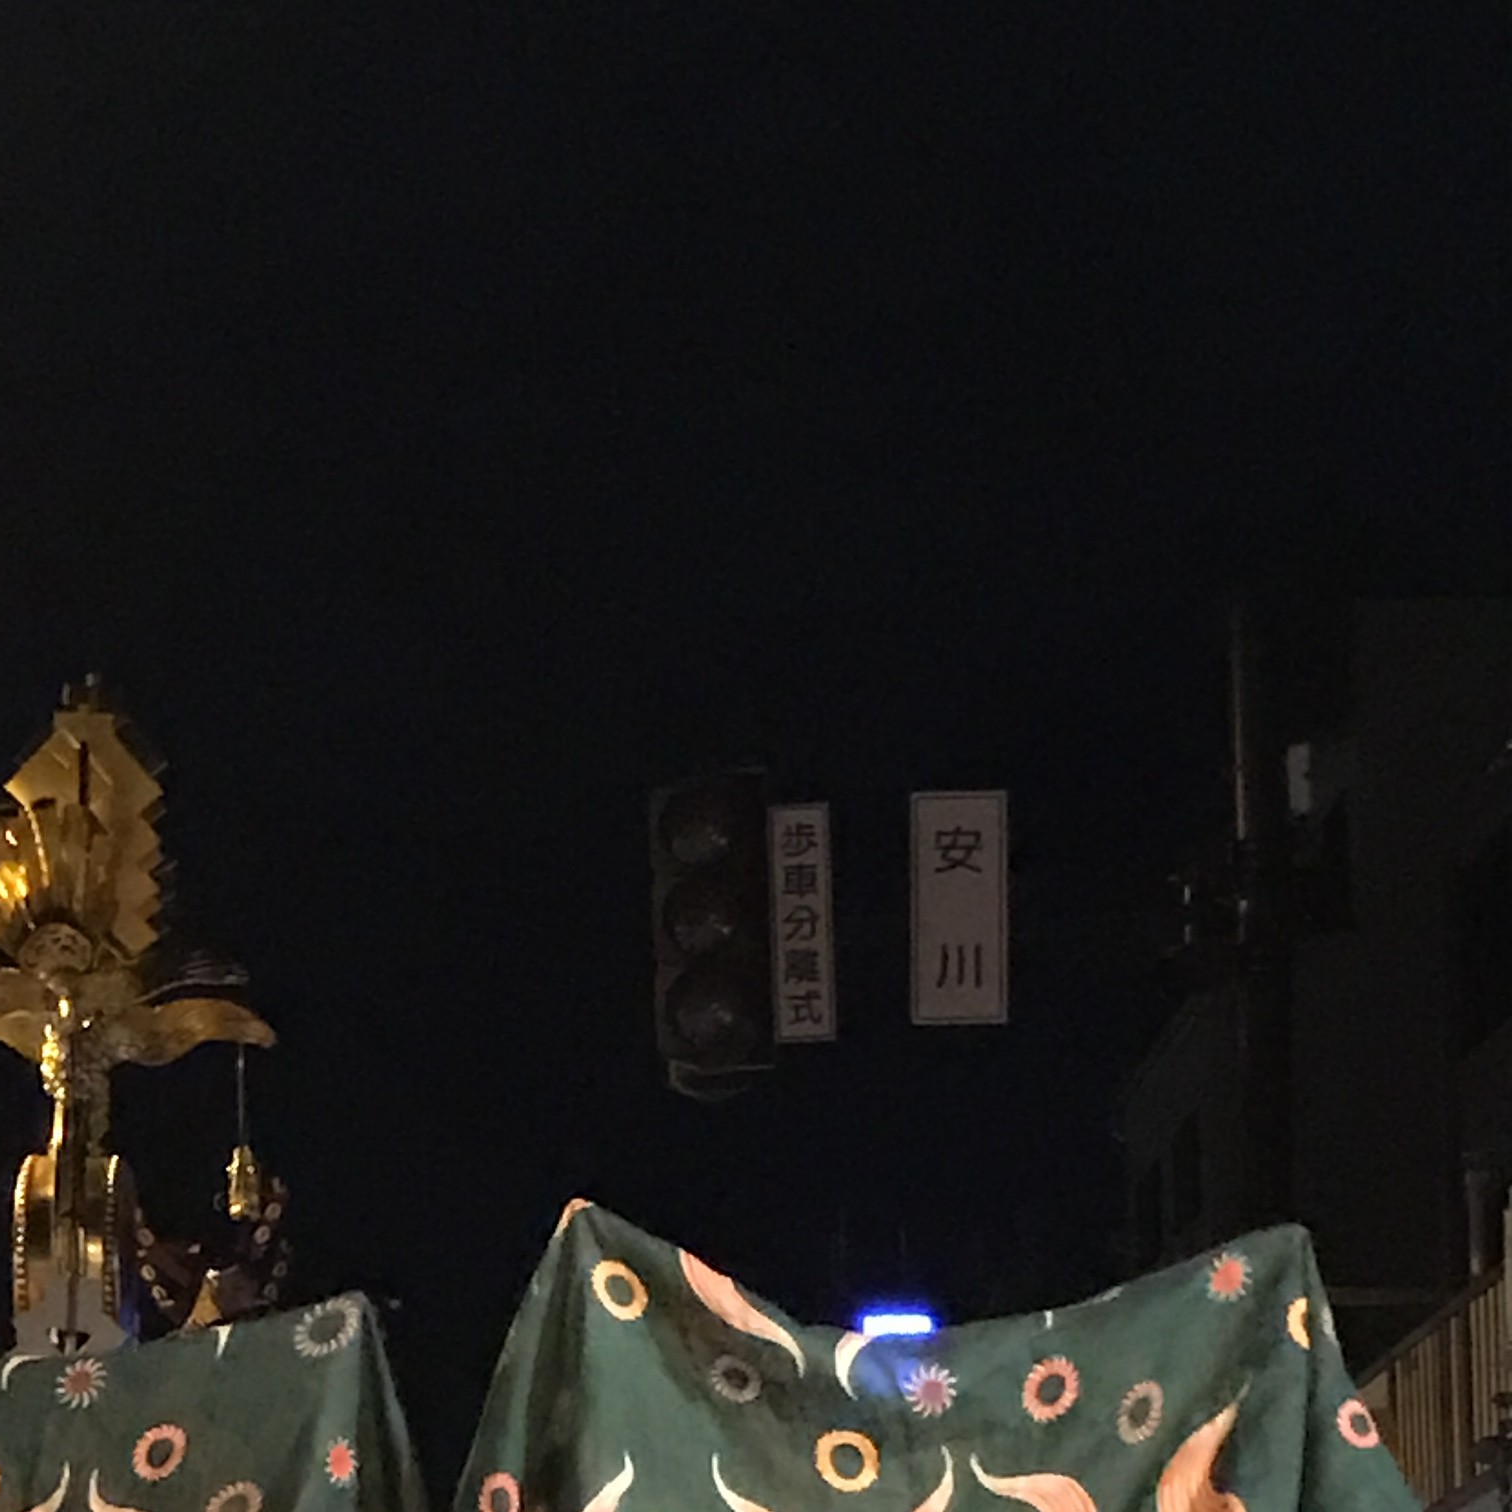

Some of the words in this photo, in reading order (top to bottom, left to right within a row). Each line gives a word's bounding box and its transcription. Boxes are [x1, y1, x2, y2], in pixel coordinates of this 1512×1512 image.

[781, 821, 822, 1026] 歩車分離式
[933, 825, 983, 989] 安川
